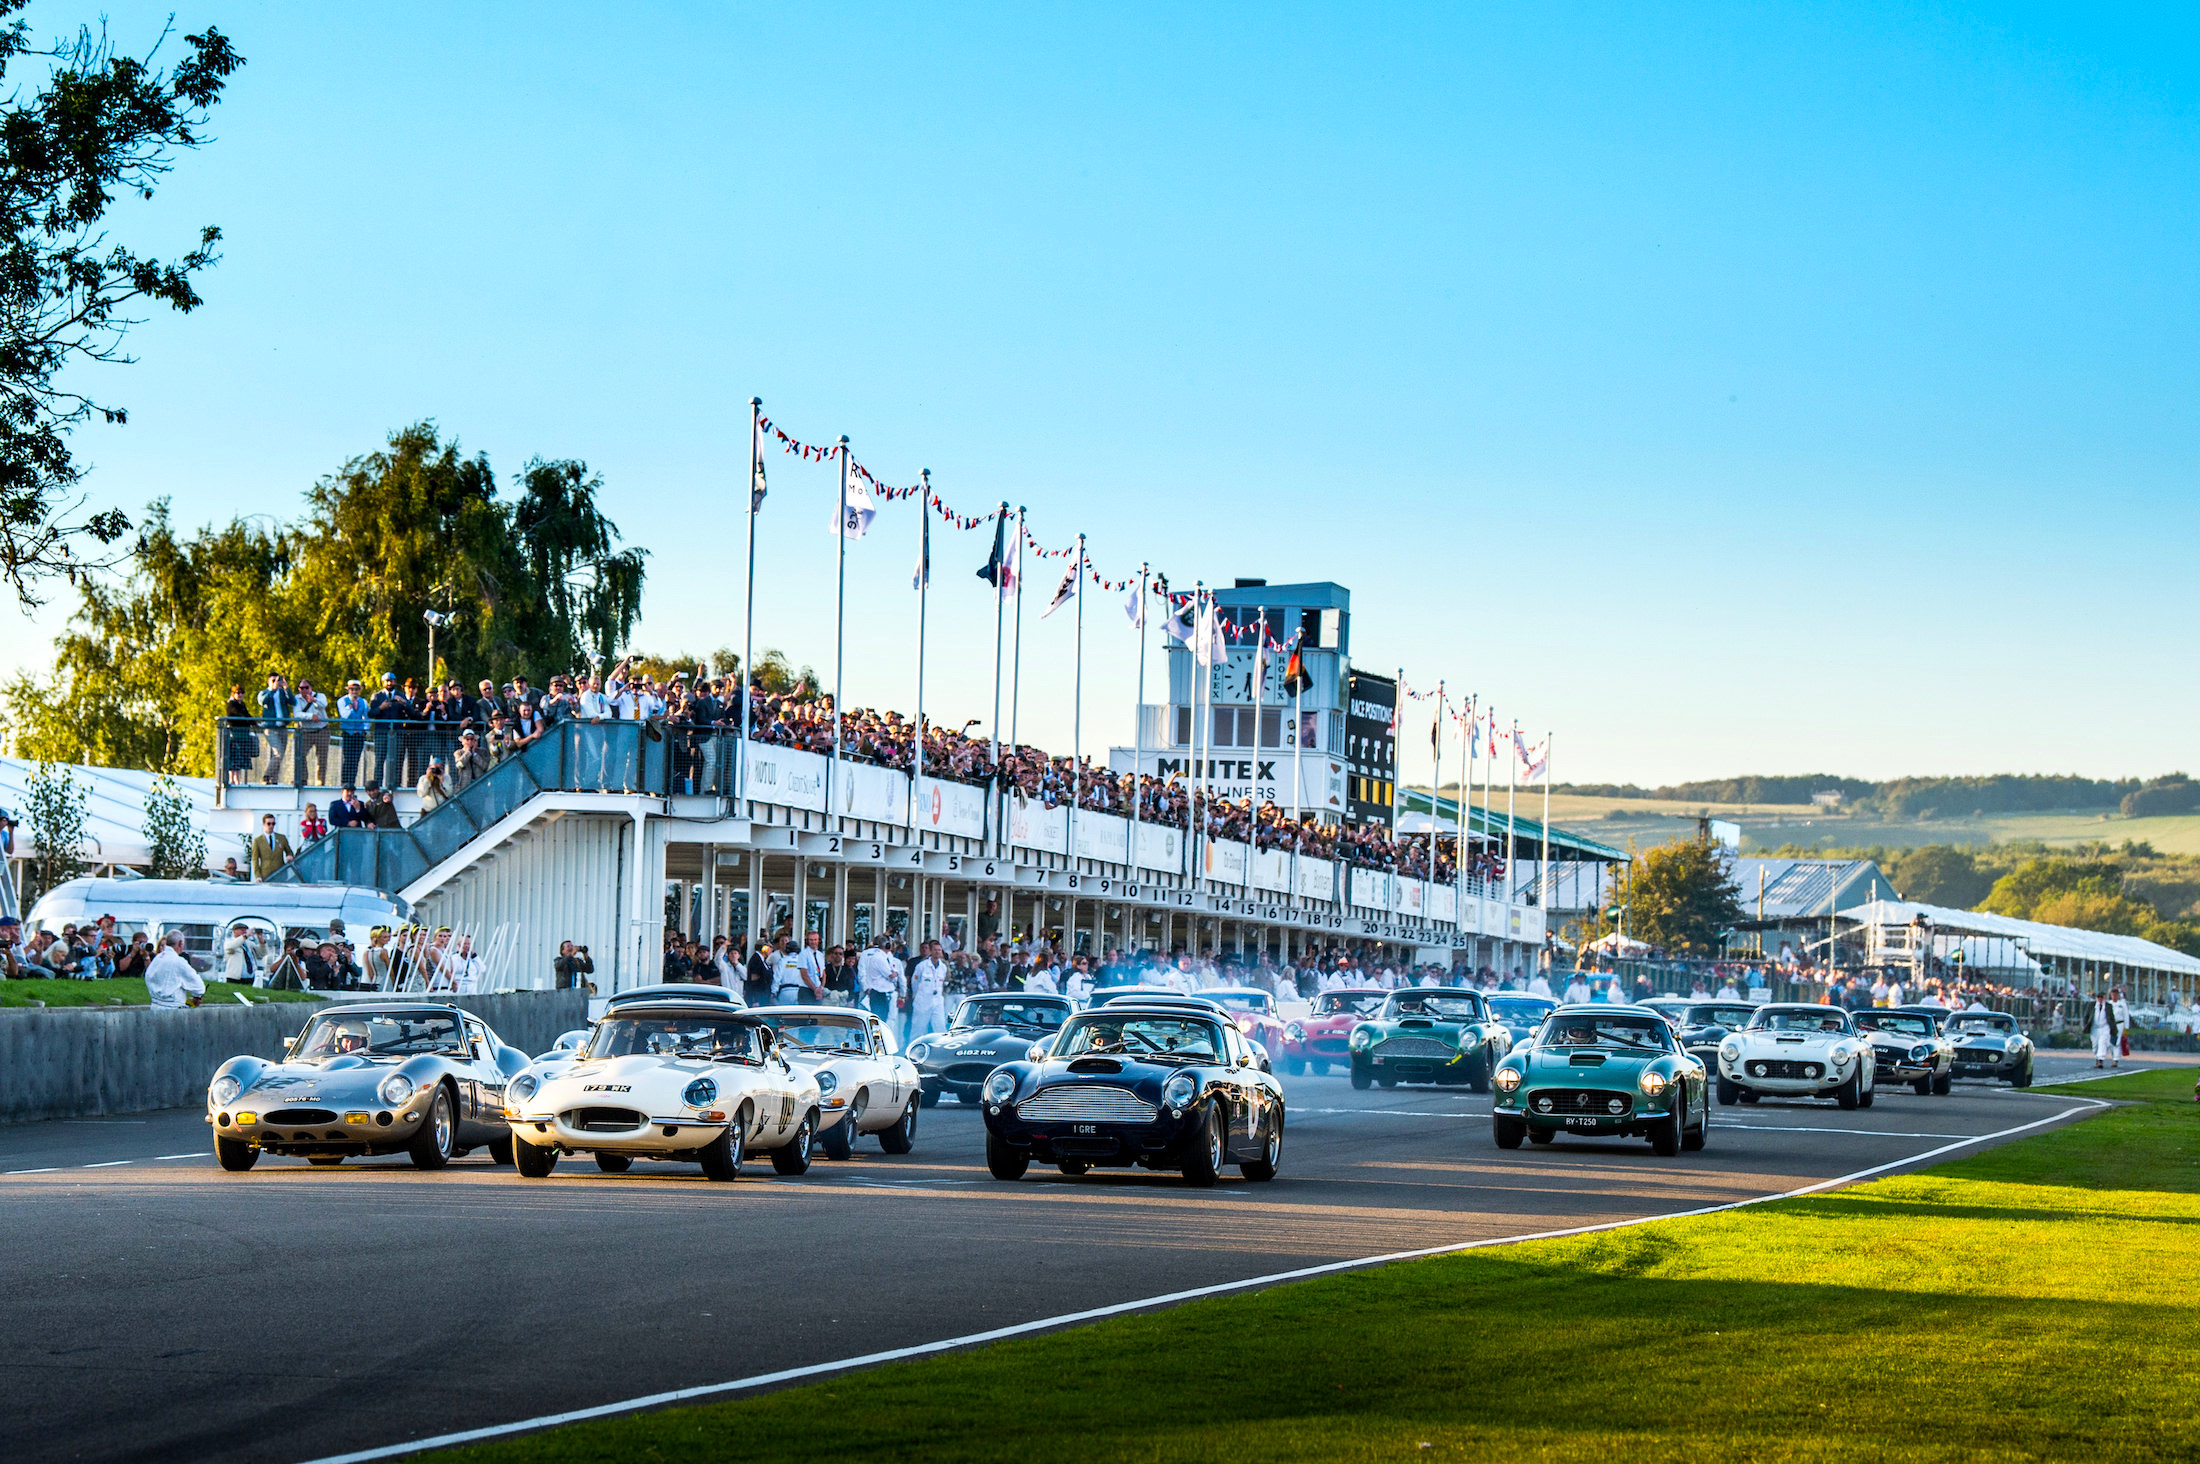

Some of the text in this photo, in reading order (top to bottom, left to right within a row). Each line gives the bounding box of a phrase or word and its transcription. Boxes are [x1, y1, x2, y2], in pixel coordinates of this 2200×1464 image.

[1212, 664, 1221, 698] OLEX
[1277, 656, 1286, 700] ROLEX
[1350, 697, 1393, 725] RACE POSITIONS
[789, 830, 794, 846] 1
[829, 837, 839, 853] 2
[871, 844, 881, 859] 3
[910, 850, 921, 865] 4
[949, 856, 958, 870] 5
[985, 862, 995, 876] 6
[1036, 869, 1046, 883] 7
[1068, 874, 1078, 888] 8
[1100, 880, 1110, 893] 9
[1122, 884, 1137, 897] 10
[1153, 889, 1166, 902] 11
[1177, 893, 1193, 906] 12
[1215, 899, 1230, 911] 14
[1241, 903, 1255, 915] 15
[1263, 907, 1277, 919] 16
[1286, 910, 1299, 921] 17
[1307, 914, 1321, 925] 18
[1328, 917, 1342, 928] 19
[1363, 922, 1379, 934] 20
[1384, 926, 1397, 937] 21
[1401, 928, 1415, 940] 22
[1419, 932, 1432, 942] 23
[1434, 935, 1447, 945] 24
[1452, 937, 1466, 947] 25
[611, 1085, 630, 1093] WK
[1079, 1124, 1097, 1134] GRE
